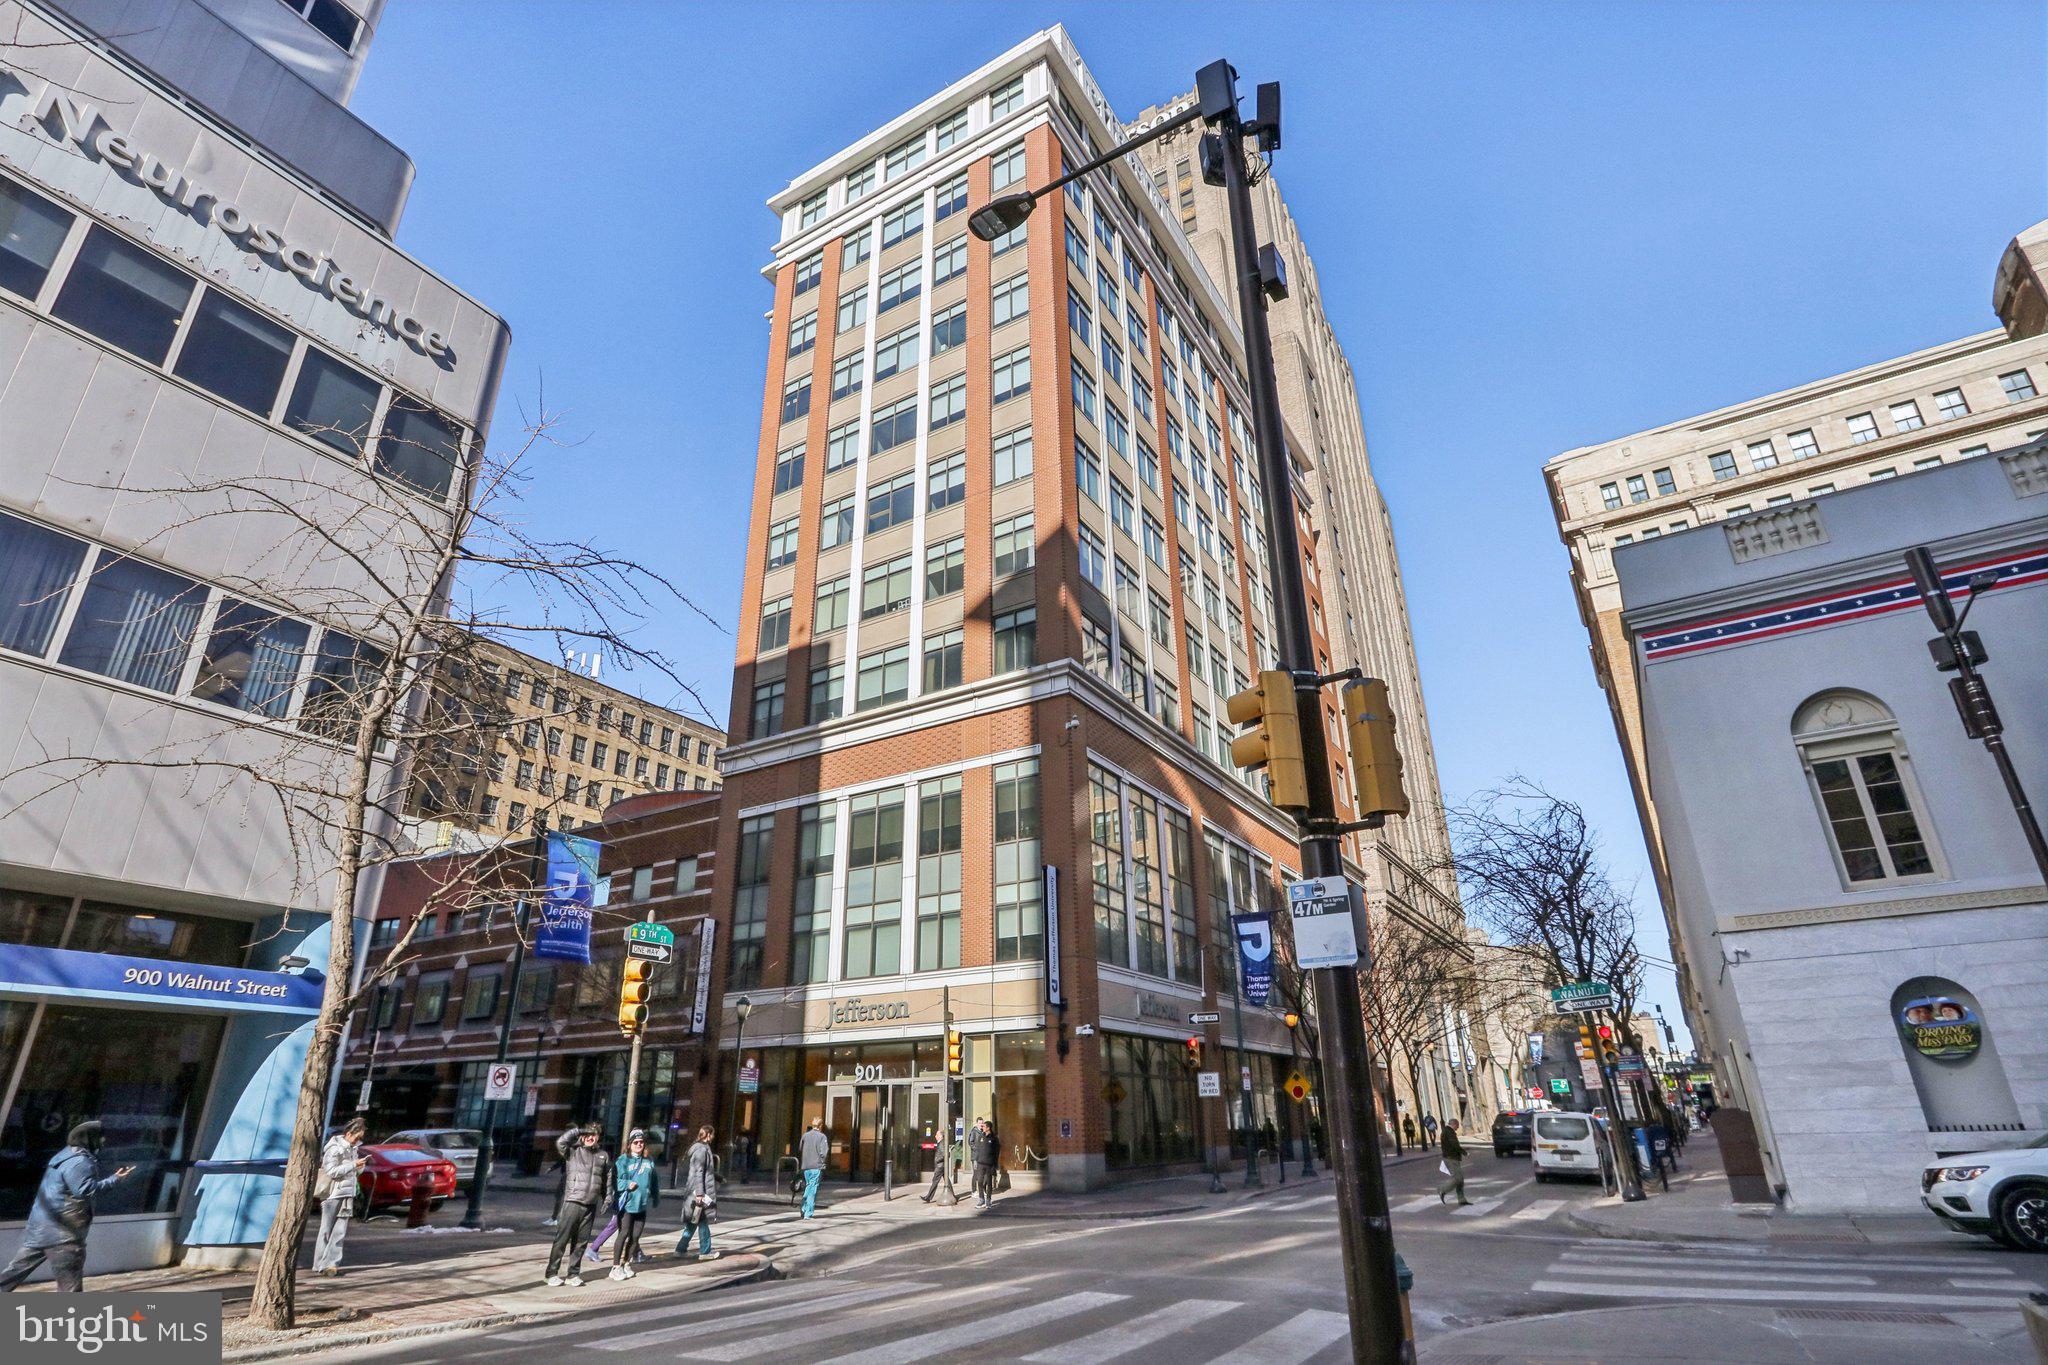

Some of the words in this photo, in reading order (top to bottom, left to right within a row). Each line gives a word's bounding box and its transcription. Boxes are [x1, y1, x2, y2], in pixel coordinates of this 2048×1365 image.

[32, 82, 450, 357] Neuroscience
[640, 929, 647, 940] 9
[633, 945, 646, 954] ONE
[123, 968, 163, 987] 900
[168, 972, 232, 994] Walnut
[235, 979, 288, 998] Street
[1560, 987, 1596, 999] WALNUT
[826, 998, 910, 1030] Jefferson
[1915, 1026, 1966, 1038] DRIVING
[855, 1063, 883, 1083] 901
